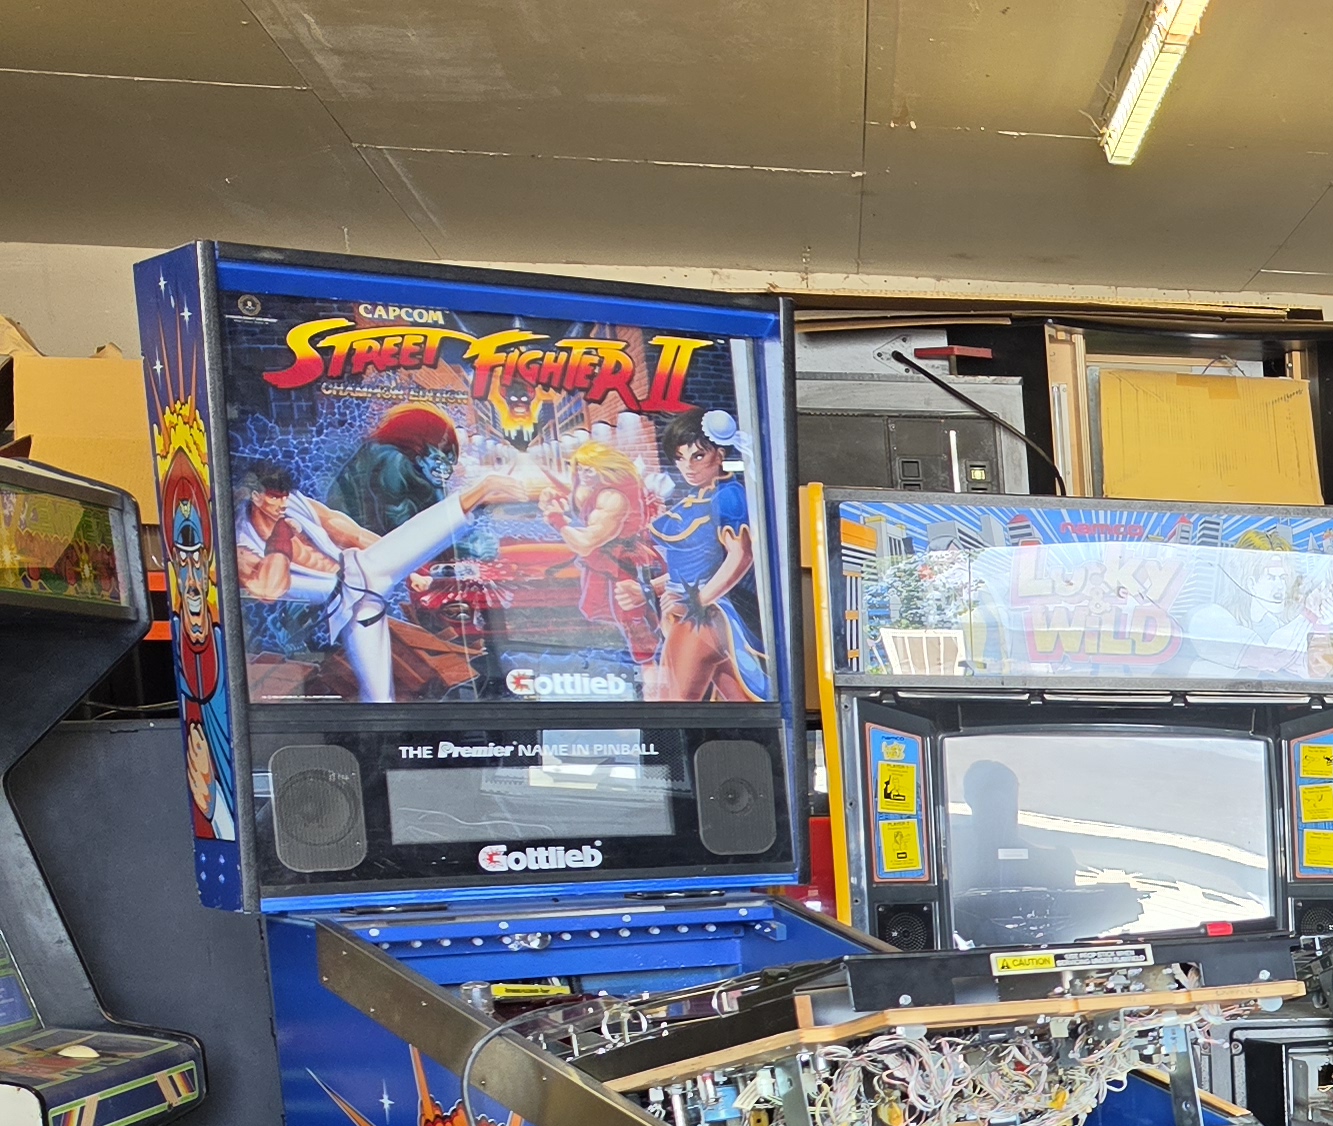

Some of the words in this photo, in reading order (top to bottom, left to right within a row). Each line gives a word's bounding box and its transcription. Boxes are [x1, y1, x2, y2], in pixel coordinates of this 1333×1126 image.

[358, 303, 446, 325] CAPCOM
[262, 317, 478, 389] STREET
[462, 328, 642, 413] FIGHTER
[1058, 521, 1143, 537] namco
[506, 668, 627, 695] Gottlieb
[398, 746, 434, 759] THE
[438, 741, 514, 759] Premier
[518, 743, 569, 757] NAME
[572, 743, 587, 756] IN
[594, 742, 660, 756] PINBALL
[478, 844, 602, 872] Gottlieb
[1012, 956, 1051, 967] CAUTION
